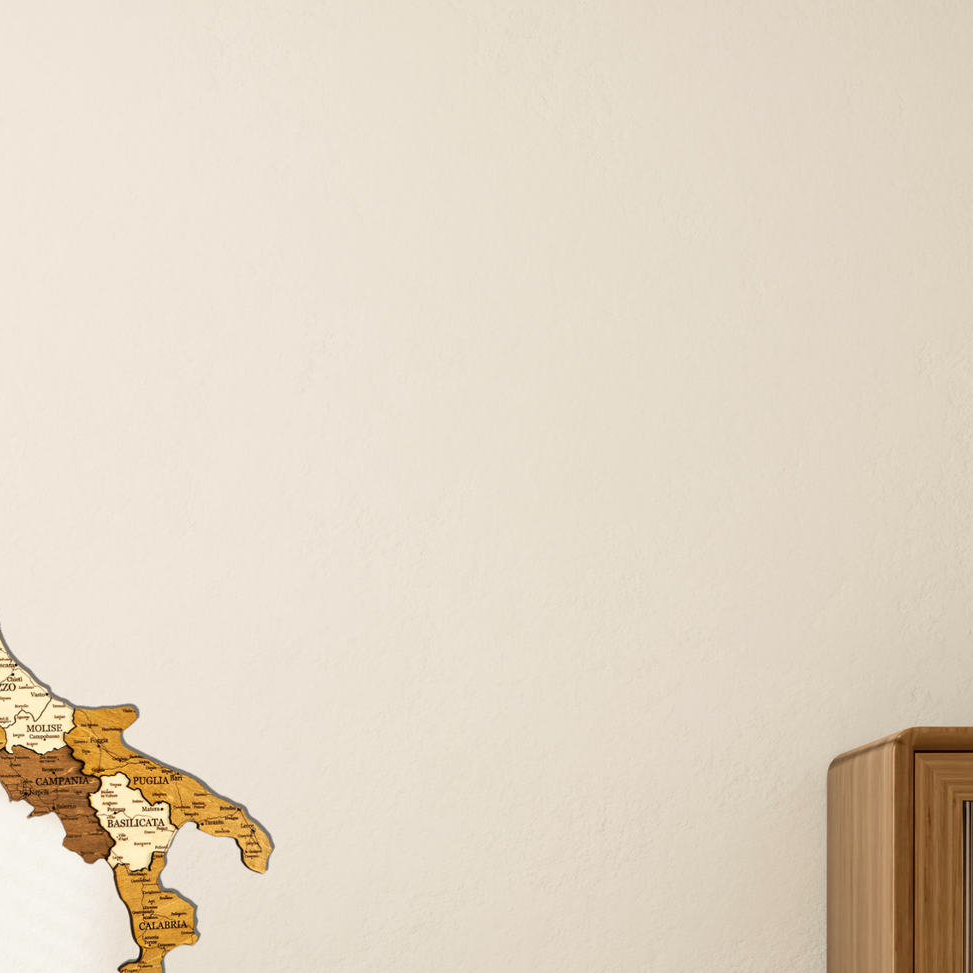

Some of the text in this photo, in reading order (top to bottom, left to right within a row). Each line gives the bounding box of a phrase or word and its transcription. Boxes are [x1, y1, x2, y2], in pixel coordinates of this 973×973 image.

[26, 724, 63, 733] MOLISE
[35, 776, 89, 786] CAMPANIA
[133, 776, 169, 785] PUGLIA
[107, 818, 165, 828] BASILICATA
[138, 920, 188, 931] CALABRIA
